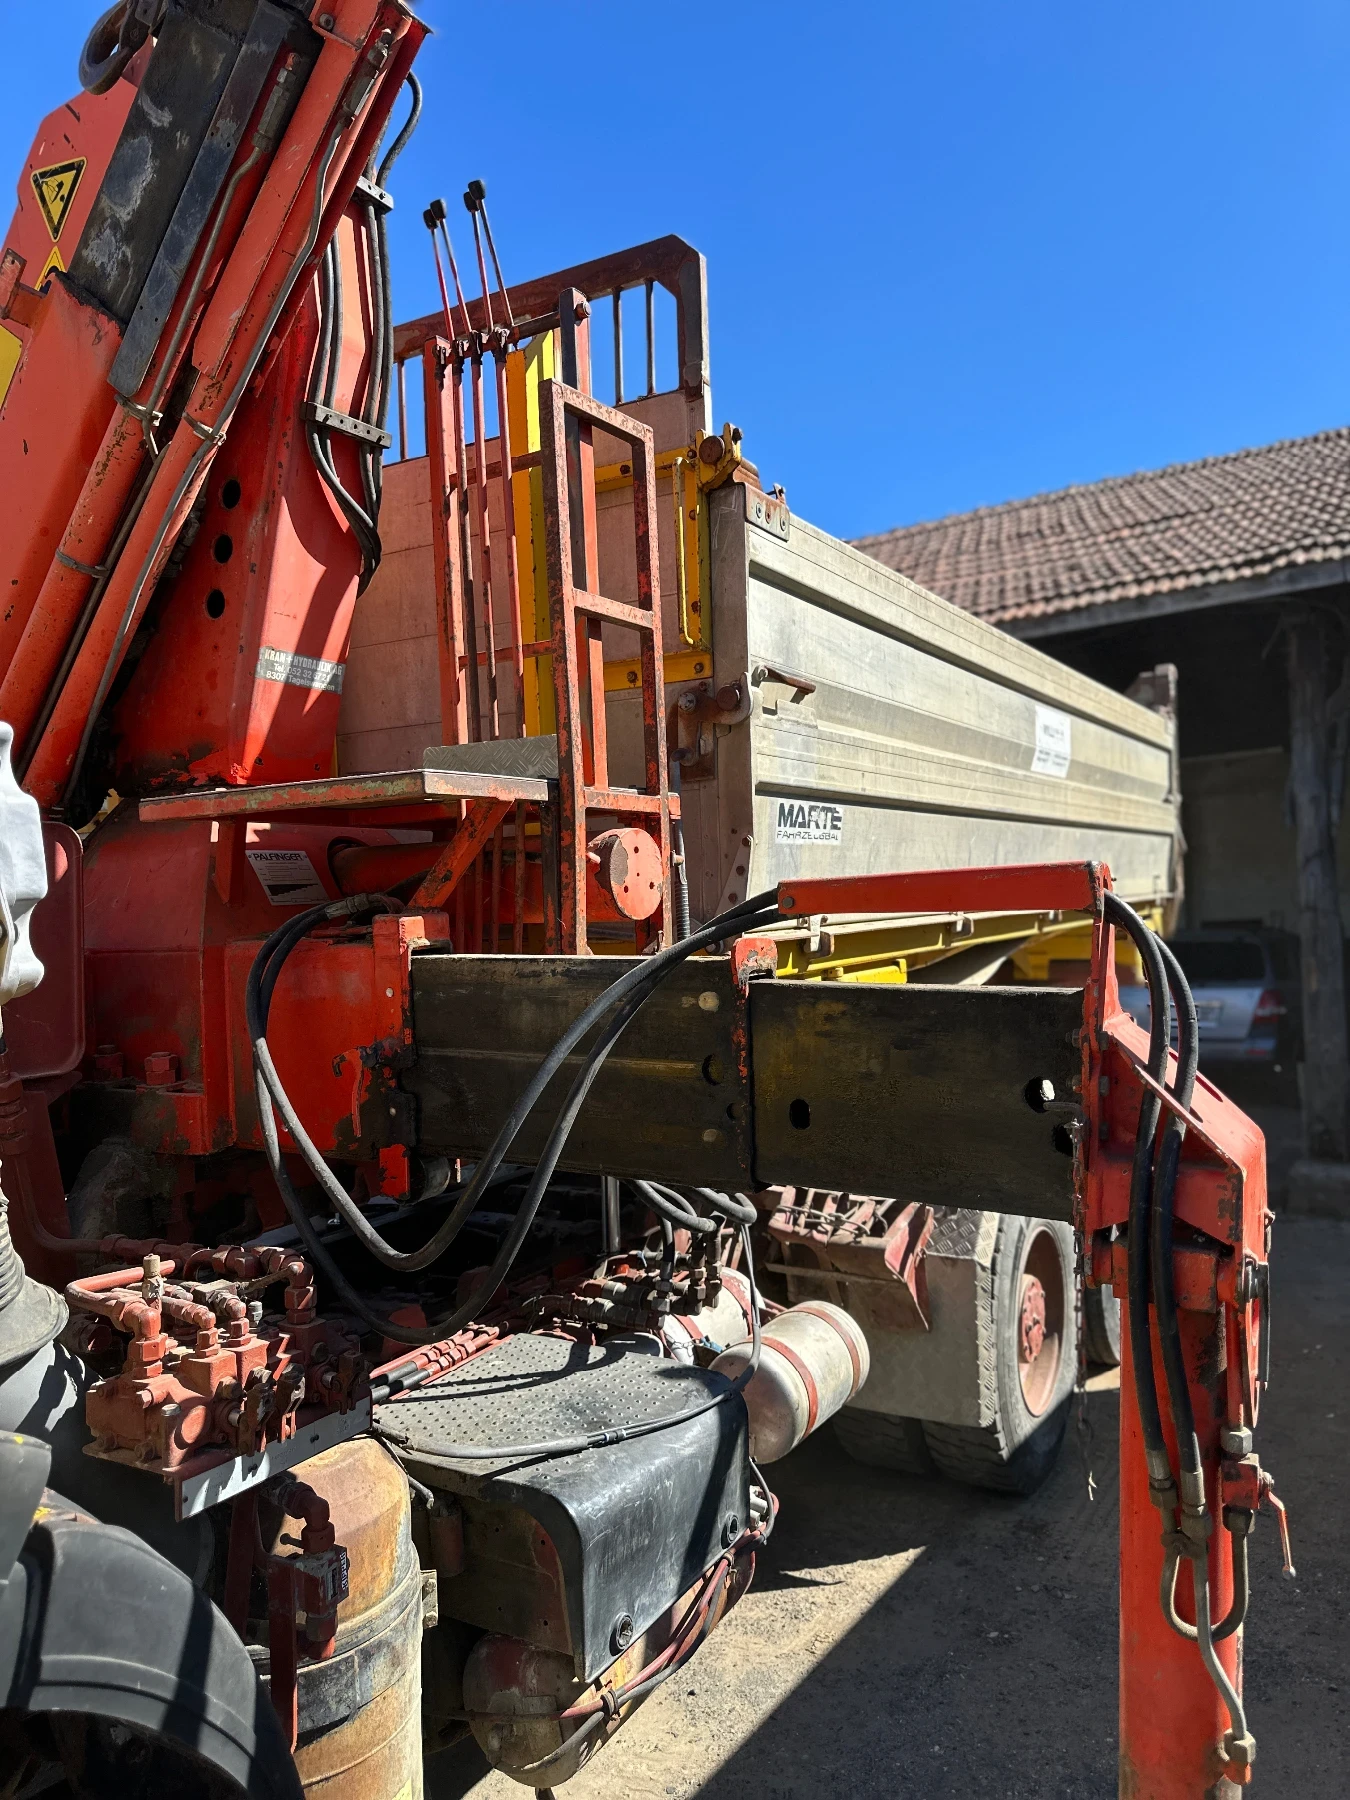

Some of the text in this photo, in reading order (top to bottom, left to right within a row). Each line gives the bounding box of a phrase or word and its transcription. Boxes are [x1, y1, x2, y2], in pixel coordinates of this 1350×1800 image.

[264, 649, 286, 663] KRAN
[293, 656, 332, 673] HYDRAULIK
[333, 665, 343, 676] AG
[266, 670, 286, 681] 8307
[287, 666, 302, 676] 052
[302, 671, 312, 679] 32
